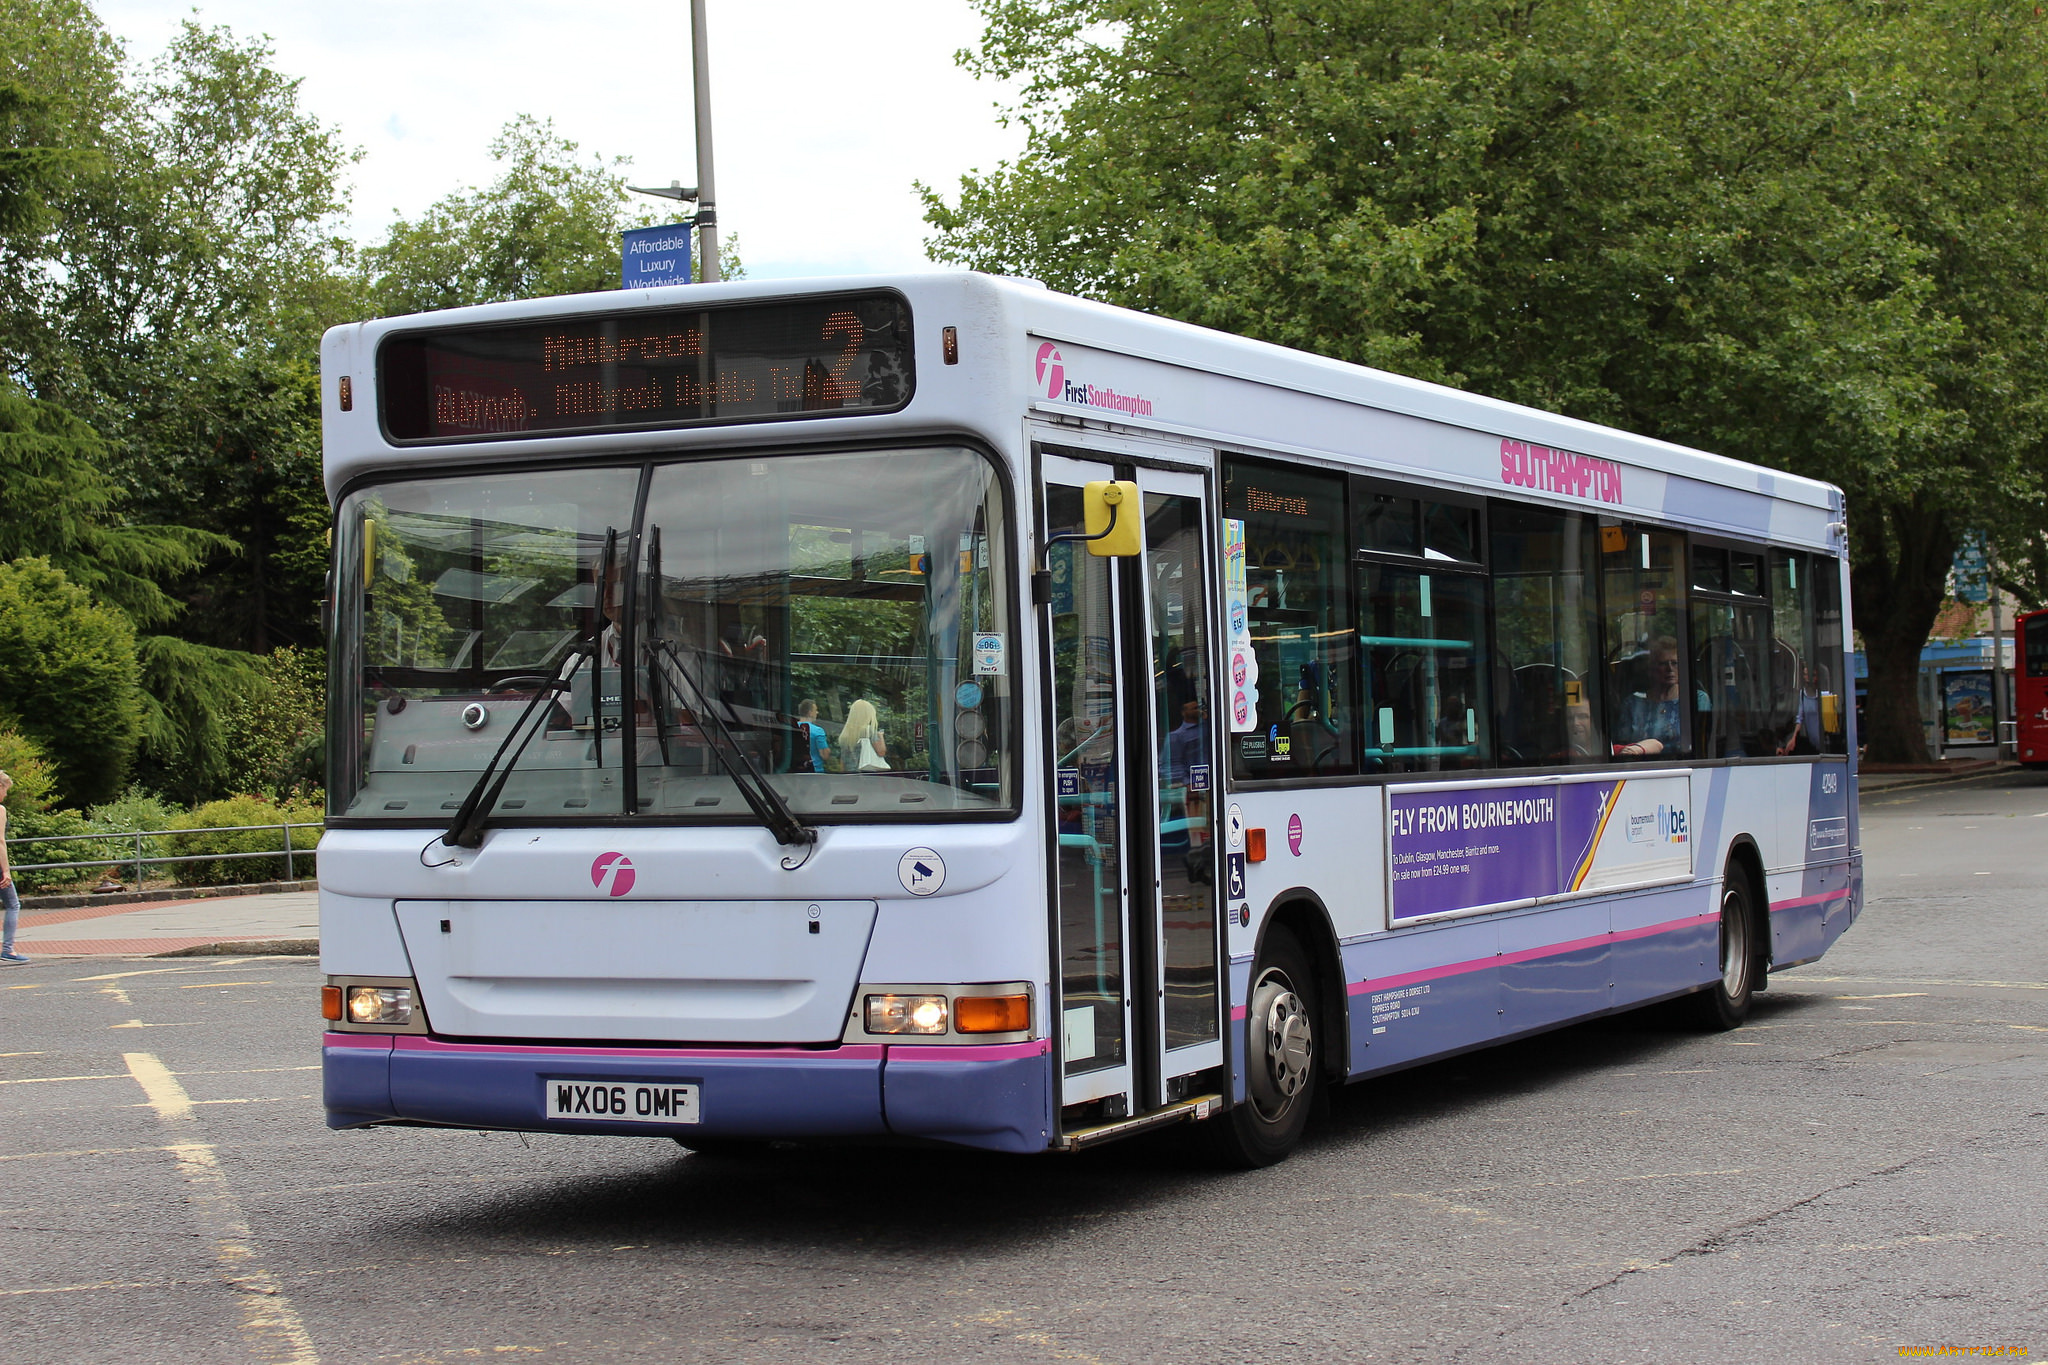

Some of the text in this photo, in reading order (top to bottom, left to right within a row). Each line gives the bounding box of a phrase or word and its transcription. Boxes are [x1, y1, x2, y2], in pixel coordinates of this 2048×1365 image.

[629, 236, 684, 255] Affordable
[640, 259, 676, 273] Luxury
[544, 329, 704, 372] Millbrook
[822, 311, 864, 400] 2
[556, 376, 663, 416] Millbrook
[676, 370, 755, 407] Weekly
[1500, 438, 1623, 505] SOUTHAMPTON
[1063, 779, 1073, 787] PUSH
[1392, 798, 1553, 837] FLY FROM BOURNEMOUTH
[1393, 854, 1399, 865] To
[1399, 852, 1415, 865] Dublin,
[1415, 851, 1437, 863] Glasgow,
[1437, 848, 1465, 860] Manchester,
[1480, 844, 1488, 855] and
[1488, 845, 1500, 854] more.
[1393, 864, 1470, 881] On sale now from £24.99 one way.
[1372, 994, 1383, 1004] FIRST
[1383, 989, 1406, 1002] HAMPSHIRE
[1409, 986, 1423, 997] DORSET
[1423, 984, 1431, 994] LTD
[1372, 1000, 1400, 1014] EMPRESS ROAD
[1372, 1011, 1400, 1024] SOUTHAMPTON
[557, 1085, 688, 1117] WX06 OMF
